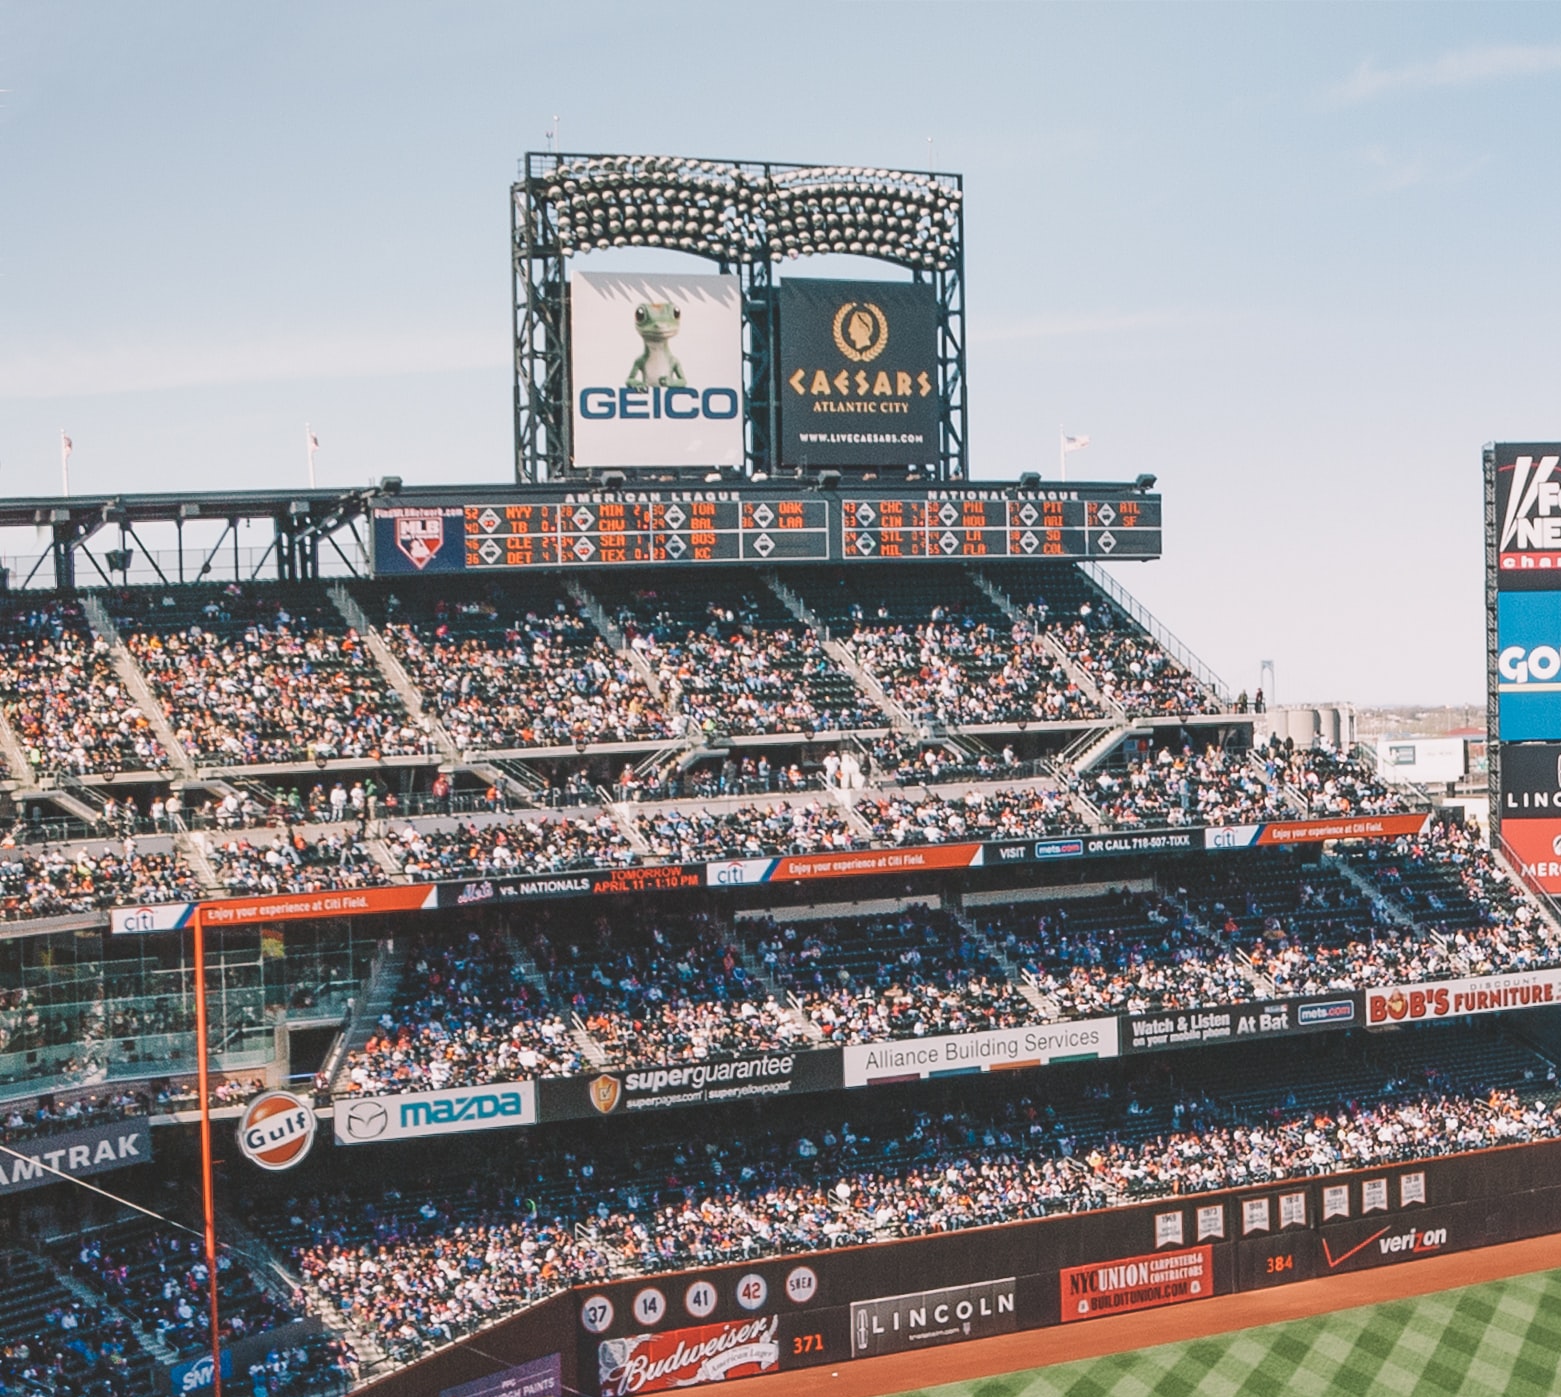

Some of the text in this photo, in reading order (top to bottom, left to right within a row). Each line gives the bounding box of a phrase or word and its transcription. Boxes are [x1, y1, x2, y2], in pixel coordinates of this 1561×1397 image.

[789, 368, 932, 397] CAESARS
[580, 387, 738, 419] GEICO
[813, 401, 908, 413] ATLANTIC CITY
[799, 433, 923, 444] WWW.LIVECAESARS.COM
[565, 491, 740, 503] AMERICAN LEAGUE
[928, 491, 1078, 500] NATIONAL LEAGUE
[506, 506, 532, 519] NYY
[779, 503, 802, 514] OAK
[401, 520, 439, 534] MLB
[511, 521, 528, 533] TB
[610, 867, 682, 880] TOMORROW
[458, 878, 590, 902] Mets vs. NATIONALS
[593, 876, 698, 893] APRIL 11 1:10 PM
[1470, 977, 1538, 991] DISCOUNT
[1370, 988, 1449, 1022] BOB'S
[1454, 983, 1553, 1012] FURNITURE
[1132, 1014, 1231, 1036] Watch & Listen
[1237, 1012, 1288, 1035] At Bat
[866, 1027, 1099, 1070] Alliance Building Services
[625, 1056, 794, 1092] superguarantee
[401, 1092, 521, 1128] mazda
[246, 1110, 308, 1150] Gulf
[1379, 1228, 1446, 1254] verizon
[1266, 1255, 1293, 1273] 384
[693, 1290, 709, 1307] 41
[741, 1283, 760, 1300] 42
[589, 1305, 607, 1322] 37
[643, 1297, 658, 1315] 14
[872, 1293, 1015, 1334] LINCOLN
[793, 1334, 824, 1354] 371
[617, 1317, 768, 1394] Budweiser
[524, 1378, 555, 1397] PAINTS
